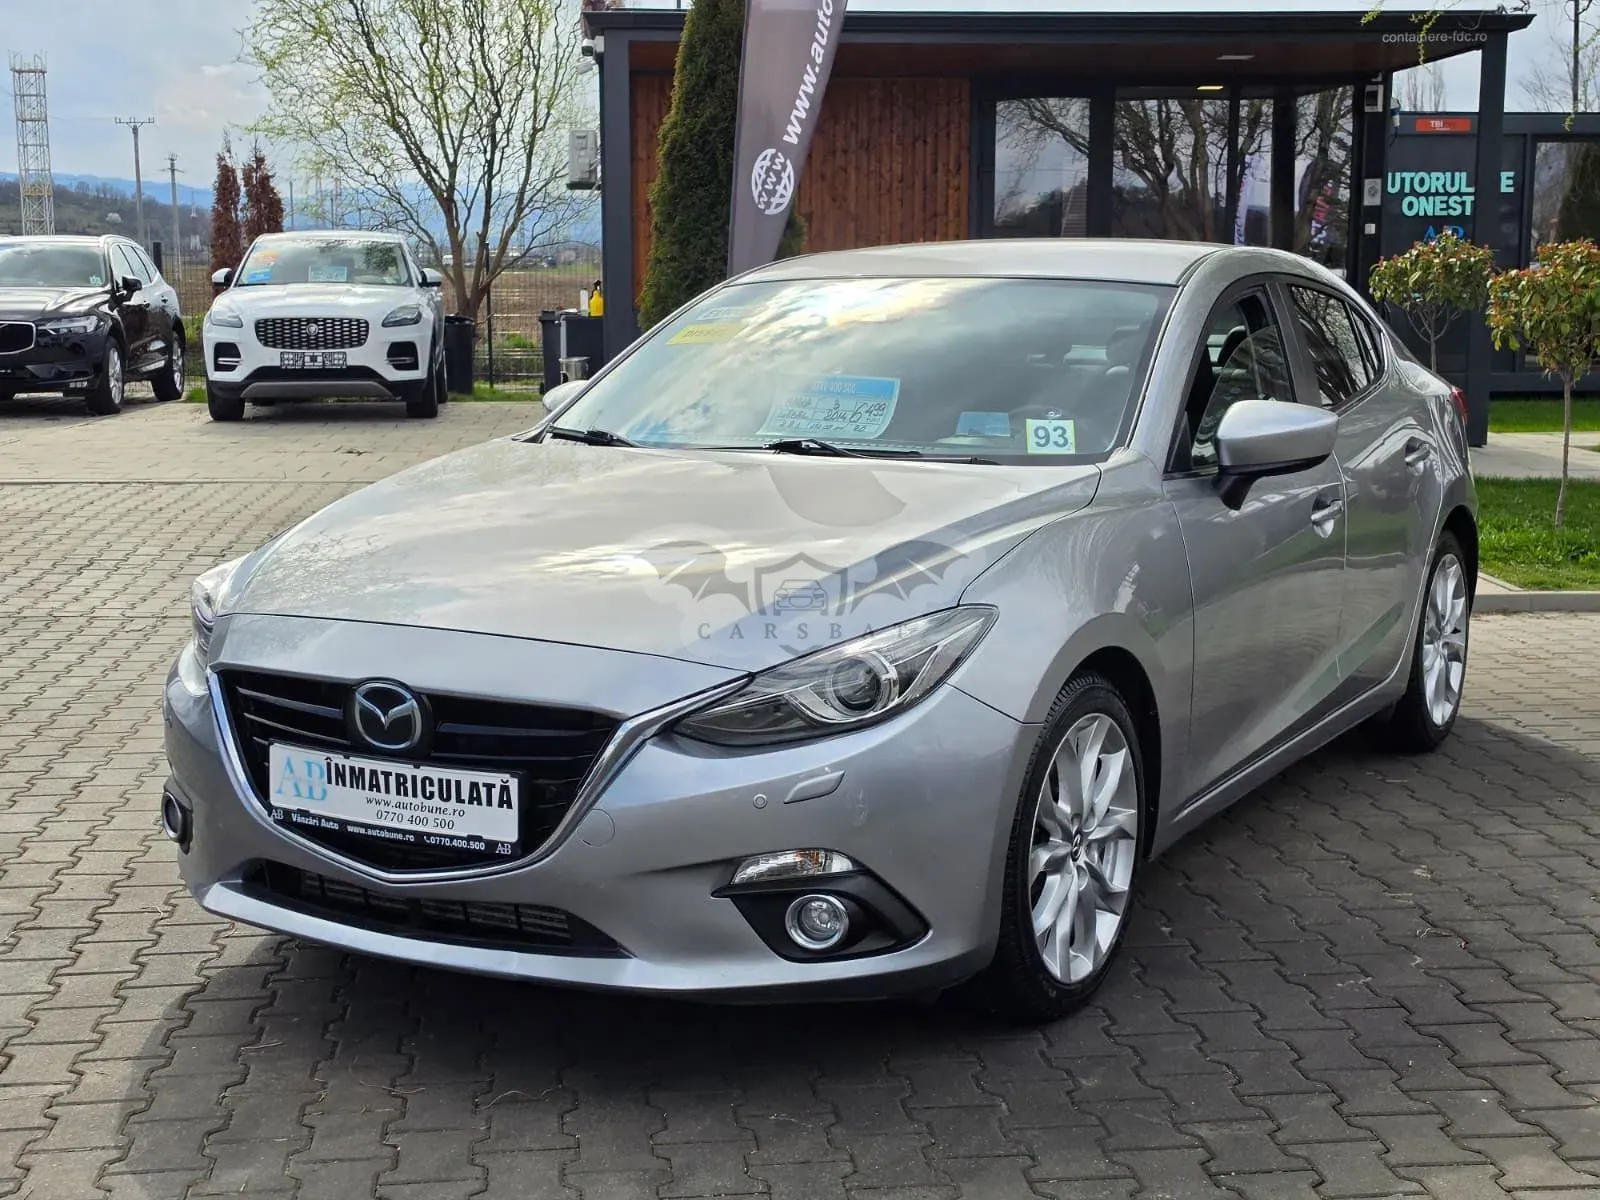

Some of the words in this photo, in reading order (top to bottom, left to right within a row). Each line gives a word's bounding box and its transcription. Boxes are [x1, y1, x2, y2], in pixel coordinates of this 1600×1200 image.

[1387, 171, 1475, 194] UTORUL
[1500, 171, 1515, 193] E
[1401, 195, 1475, 216] ONEST
[1033, 425, 1069, 449] 93
[324, 756, 513, 810] ÎNMATRICULATĂ
[365, 796, 466, 818] www.autobune.ro
[320, 818, 340, 830] Auto
[376, 810, 404, 823] 0770
[407, 814, 429, 827] 400
[432, 817, 455, 830] 500
[346, 824, 415, 842] www.autobune.ro
[430, 836, 486, 851] 0770.400.500
[495, 843, 512, 855] AB
